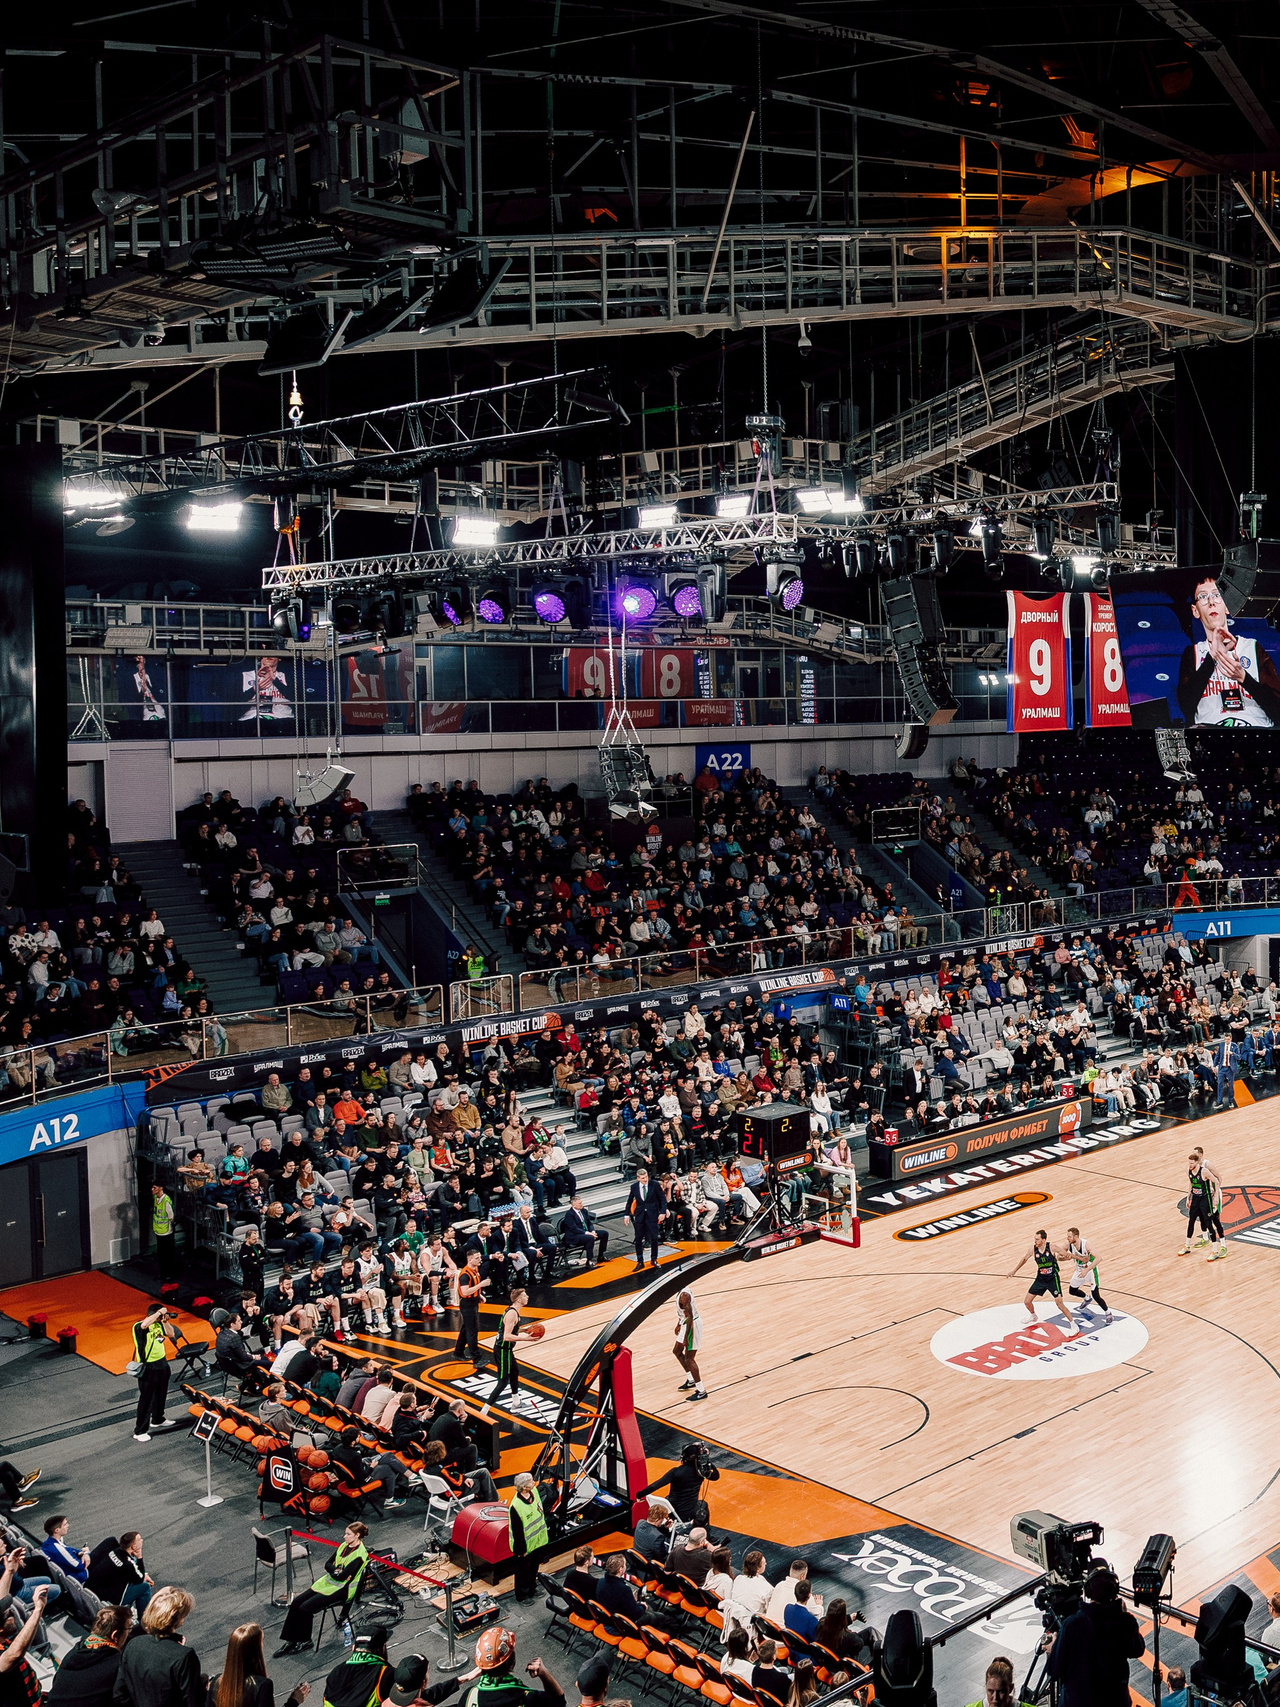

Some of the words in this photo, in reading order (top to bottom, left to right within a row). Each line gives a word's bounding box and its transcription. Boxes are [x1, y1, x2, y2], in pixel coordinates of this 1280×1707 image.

[1021, 610, 1058, 624] ДВОРНЫЙ
[1029, 639, 1051, 695] 9
[1104, 638, 1123, 692] 8
[660, 654, 681, 697] 8
[1021, 707, 1060, 719] УРАЛМАШ
[1098, 703, 1130, 714] УРАЛМАШ
[1206, 921, 1232, 937] A11
[985, 941, 1008, 954] WINLINE
[1008, 938, 1026, 950] BASKET
[1026, 936, 1035, 948] CUP
[759, 976, 789, 992] WINLINE
[790, 974, 812, 987] BASKET
[813, 971, 824, 983] CUP
[834, 998, 847, 1009] A11
[462, 1023, 498, 1042] WINLINE
[500, 1019, 530, 1035] BASKET
[532, 1016, 547, 1030] CUP
[382, 1041, 409, 1052] УРАЛМАШ
[254, 1061, 284, 1072] УРАЛМАШ
[1061, 1113, 1076, 1125] 3000
[743, 1133, 762, 1156] 21
[966, 1131, 1008, 1153] ПОЛУЧИ
[1009, 1118, 1048, 1141] ФРИБЕТ
[779, 1156, 805, 1170] WINLINE
[868, 1118, 1161, 1206] YEKATERINBURG
[904, 1148, 946, 1170] WINLINE
[905, 1199, 1022, 1239] WINLINE
[1039, 1335, 1101, 1363] GROUP
[276, 1467, 292, 1481] WIN
